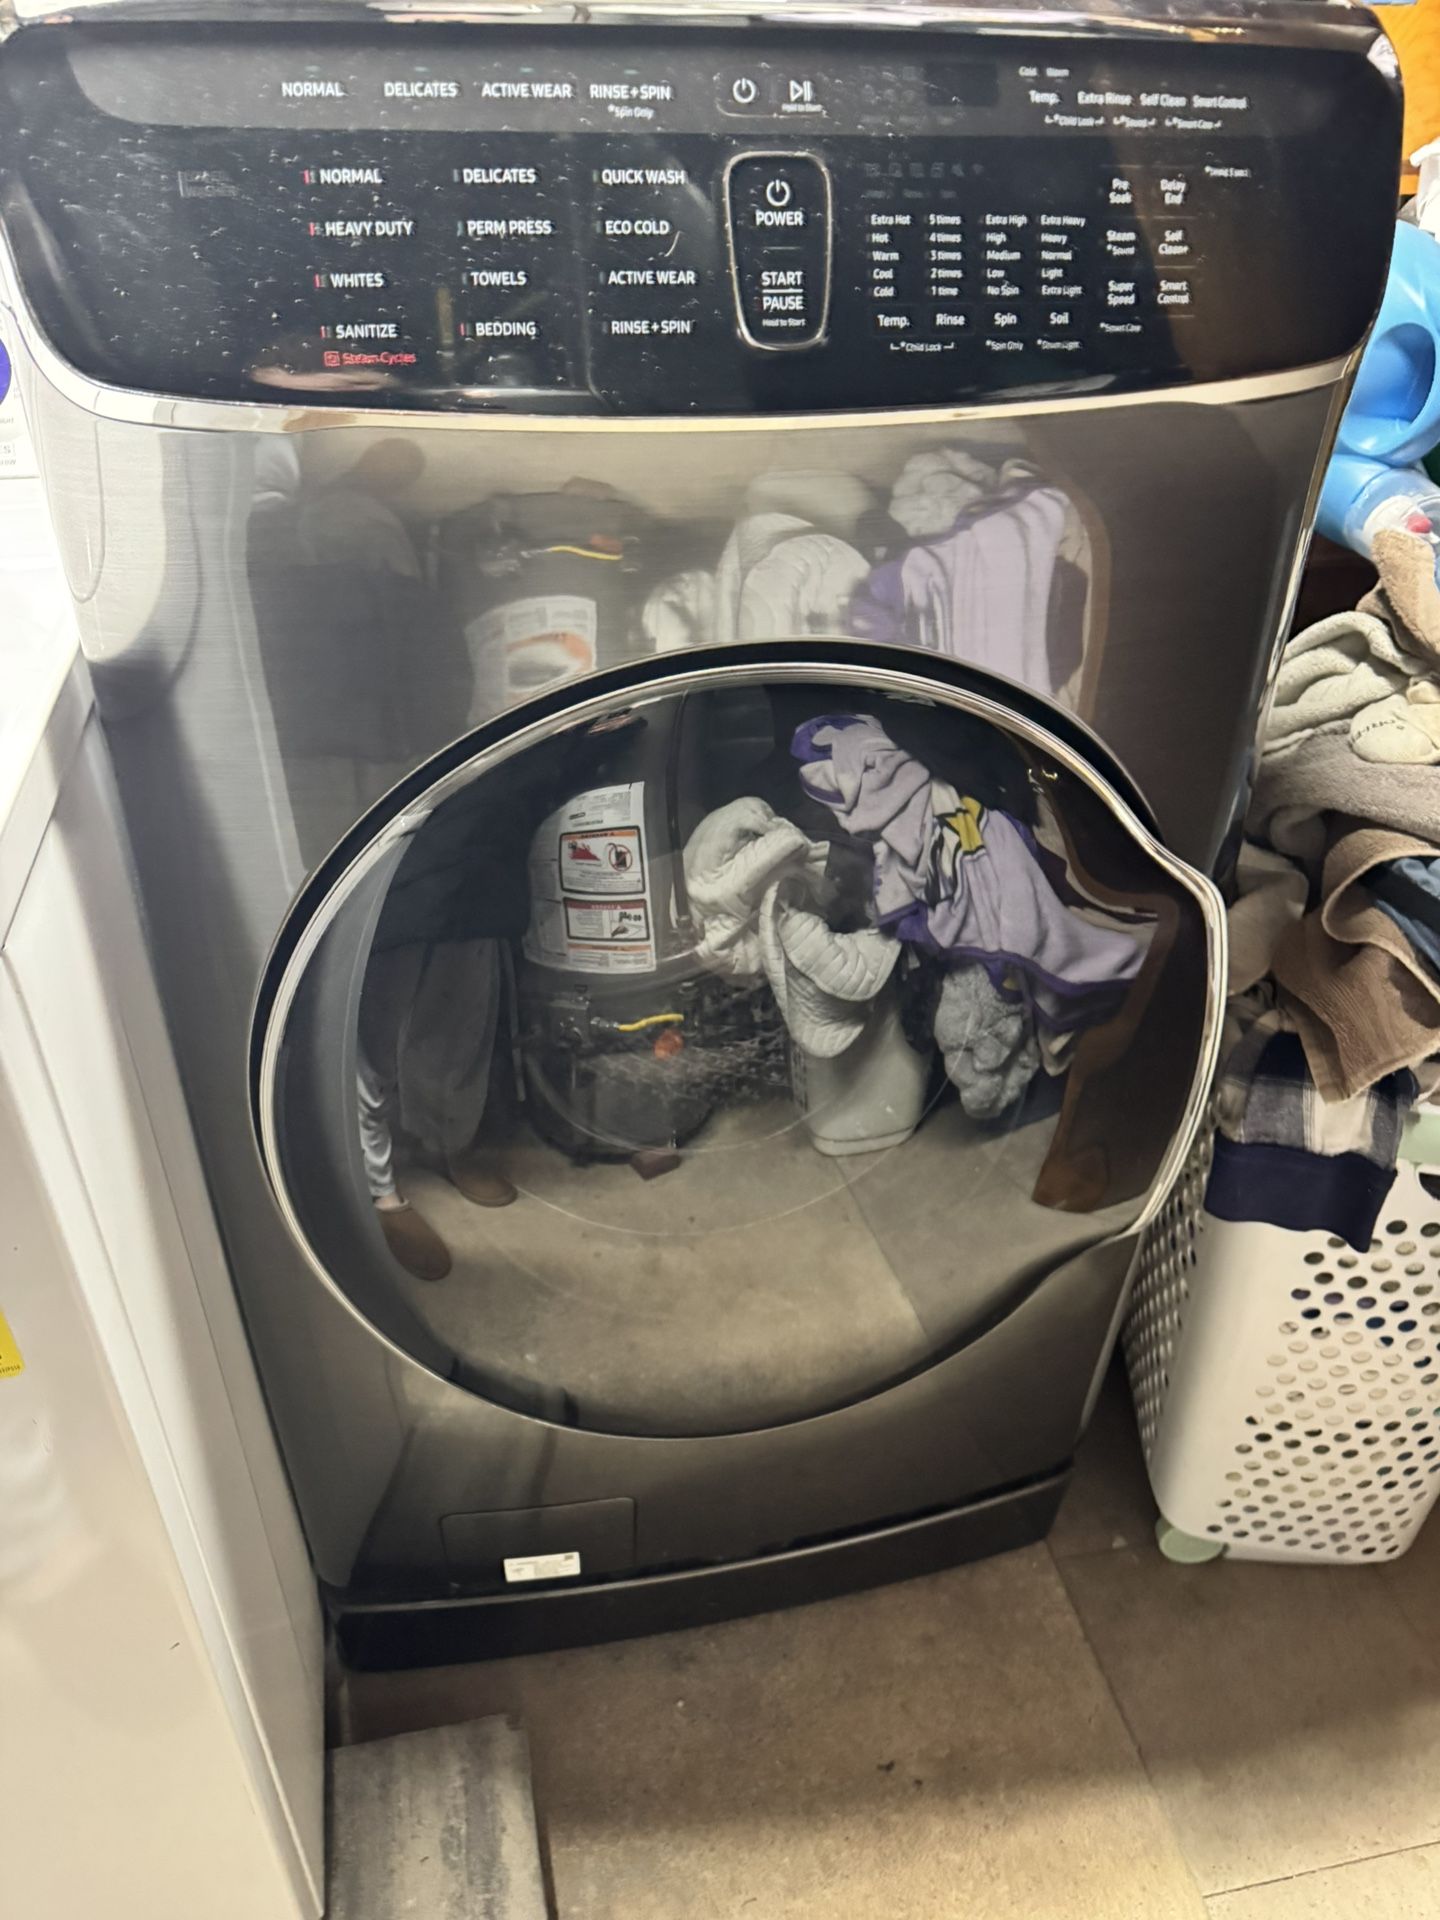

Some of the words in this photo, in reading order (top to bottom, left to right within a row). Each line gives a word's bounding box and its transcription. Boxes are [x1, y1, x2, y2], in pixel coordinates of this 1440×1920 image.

[281, 82, 344, 97] NORMAL
[384, 82, 458, 98] DELICATES
[481, 83, 530, 98] ACTIVE
[532, 84, 572, 98] WEAR
[590, 84, 630, 99] RINSE
[640, 84, 671, 100] SPIN
[319, 168, 383, 184] NORMAL
[463, 168, 536, 183] DELICATES
[602, 169, 644, 184] QUICK
[645, 169, 685, 184] WASH
[755, 210, 804, 226] POWER
[871, 214, 894, 225] Extra
[895, 214, 911, 225] Hot
[929, 214, 935, 225] 5
[936, 214, 961, 225] times
[985, 214, 1008, 225] Extra
[1009, 214, 1028, 228] High
[1041, 214, 1061, 226] Extra
[1062, 215, 1086, 227] Heavy
[325, 221, 373, 236] HEAVY
[375, 221, 413, 236] DUTY
[467, 220, 507, 235] PERM
[509, 220, 552, 235] PRESS
[605, 220, 631, 235] ECO
[634, 220, 670, 235] COLD
[871, 233, 889, 244] Hot
[929, 233, 936, 242] 4
[937, 233, 962, 243] times
[986, 232, 1007, 245] High
[1041, 233, 1068, 245] Heavy
[872, 251, 900, 262] Warm
[930, 251, 937, 261] 3
[937, 251, 962, 261] times
[986, 250, 1021, 261] Medium
[1041, 250, 1073, 261] Normal
[331, 273, 384, 288] WHITES
[471, 271, 527, 286] TOWELS
[608, 271, 654, 285] ACTIVE
[656, 271, 696, 285] WEAR
[761, 271, 803, 286] START
[873, 269, 893, 279] Cool
[930, 268, 937, 278] 2
[937, 269, 963, 279] times
[987, 269, 1005, 278] Low
[1041, 268, 1063, 280] Light
[873, 286, 894, 297] Cold
[931, 286, 936, 296] 1
[937, 286, 958, 296] time
[987, 286, 1000, 296] No
[1001, 285, 1019, 297] Spin
[762, 295, 804, 310] PAUSE
[935, 313, 965, 326] Rinse
[994, 312, 1017, 327] Spin
[1050, 312, 1069, 324] Soil
[336, 324, 398, 339] SANITIZE
[475, 322, 537, 337] BEDDING
[611, 320, 650, 335] RINSE
[660, 320, 690, 334] SPIN
[380, 351, 416, 366] Cycles
